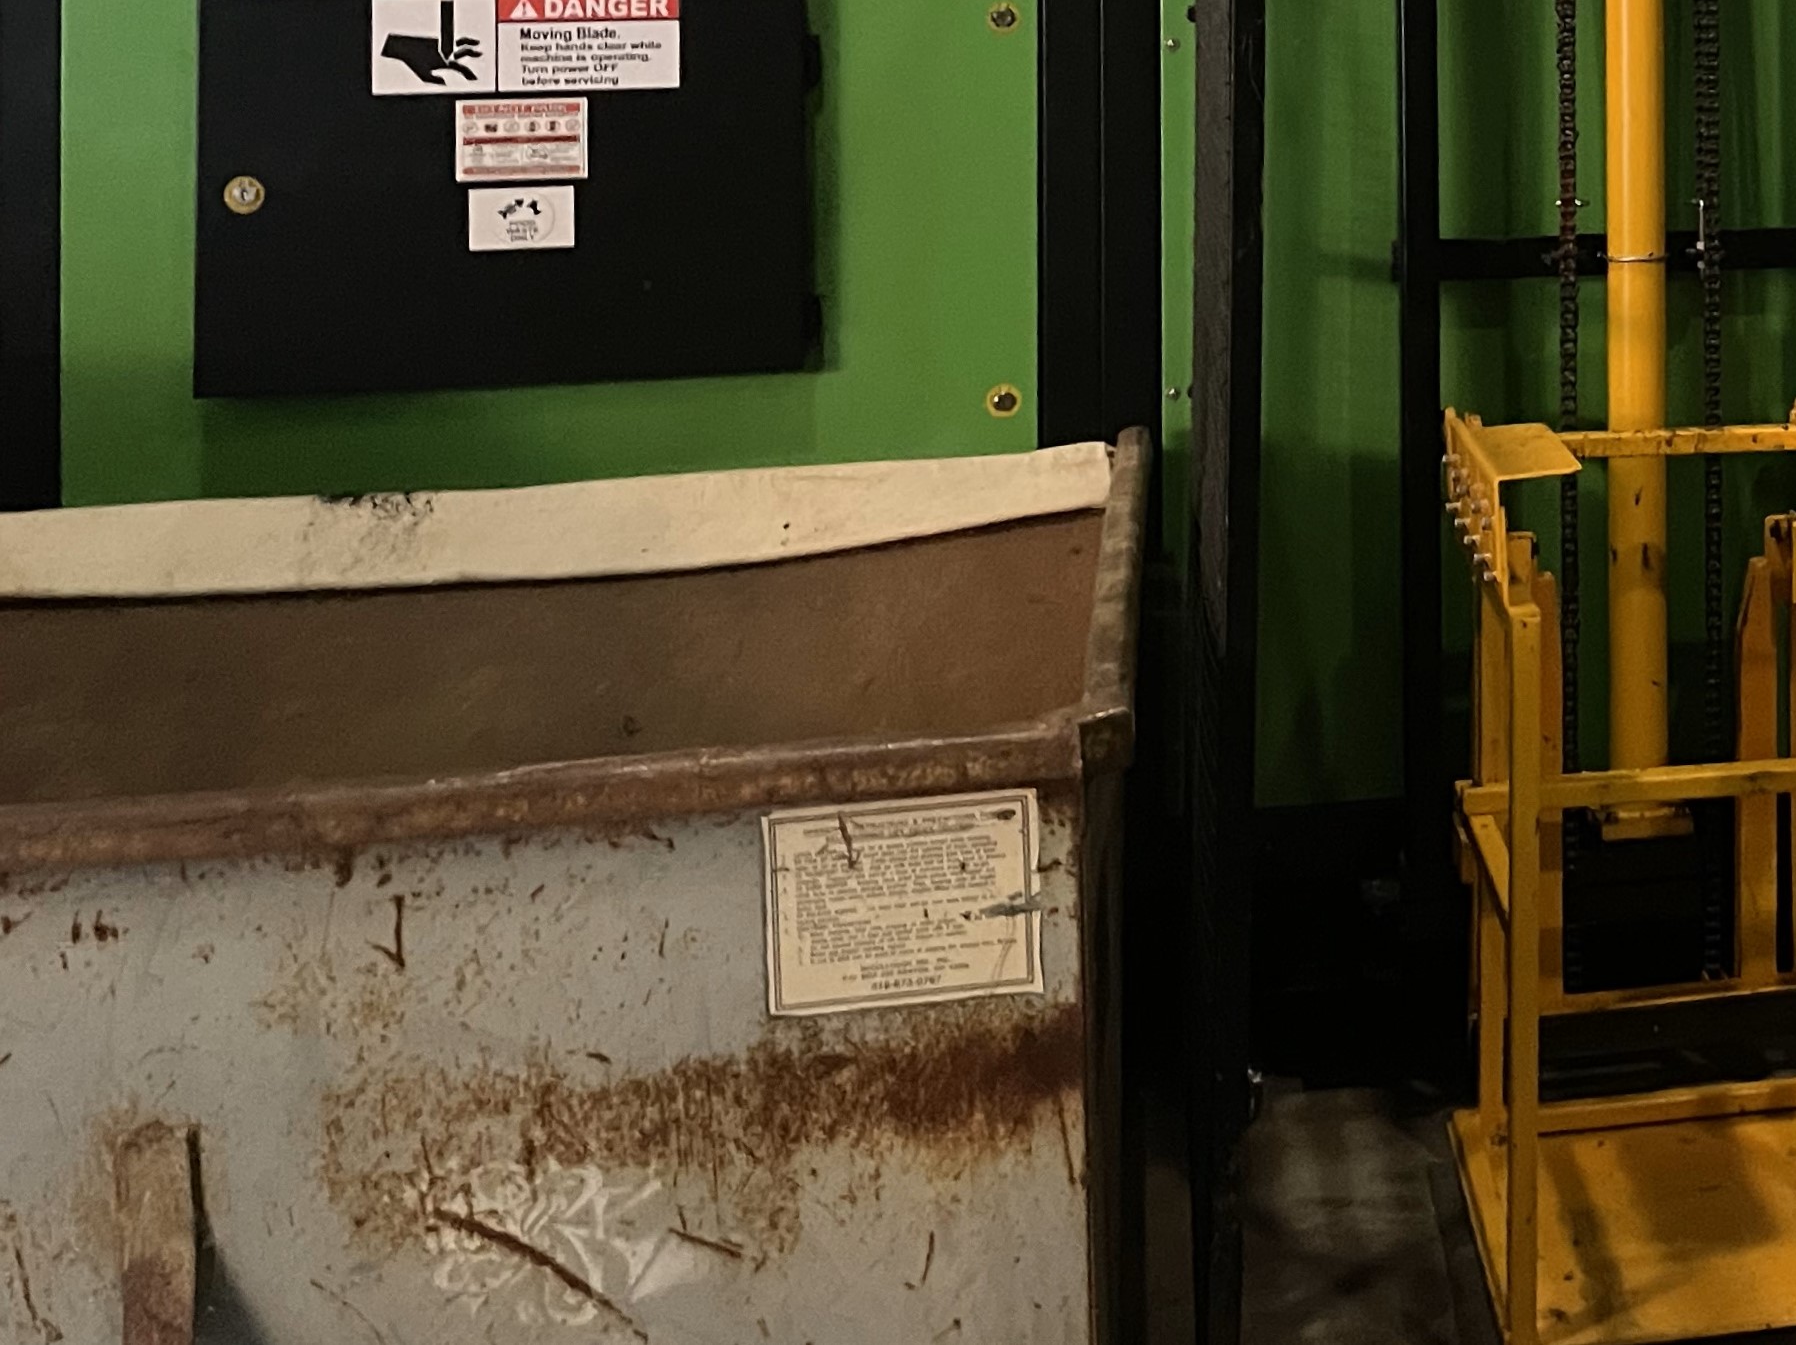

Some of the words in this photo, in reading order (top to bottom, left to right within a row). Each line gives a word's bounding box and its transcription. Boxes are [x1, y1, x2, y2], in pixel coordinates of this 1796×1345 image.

[520, 27, 572, 43] Moving
[520, 43, 551, 53] Keep
[556, 41, 593, 51] hands
[597, 41, 627, 51] clear
[630, 40, 662, 50] while
[520, 53, 573, 63] machine
[576, 53, 587, 62] is
[522, 64, 549, 73] Turn
[552, 65, 590, 74] power
[594, 62, 619, 73] OFF
[522, 76, 560, 86] before
